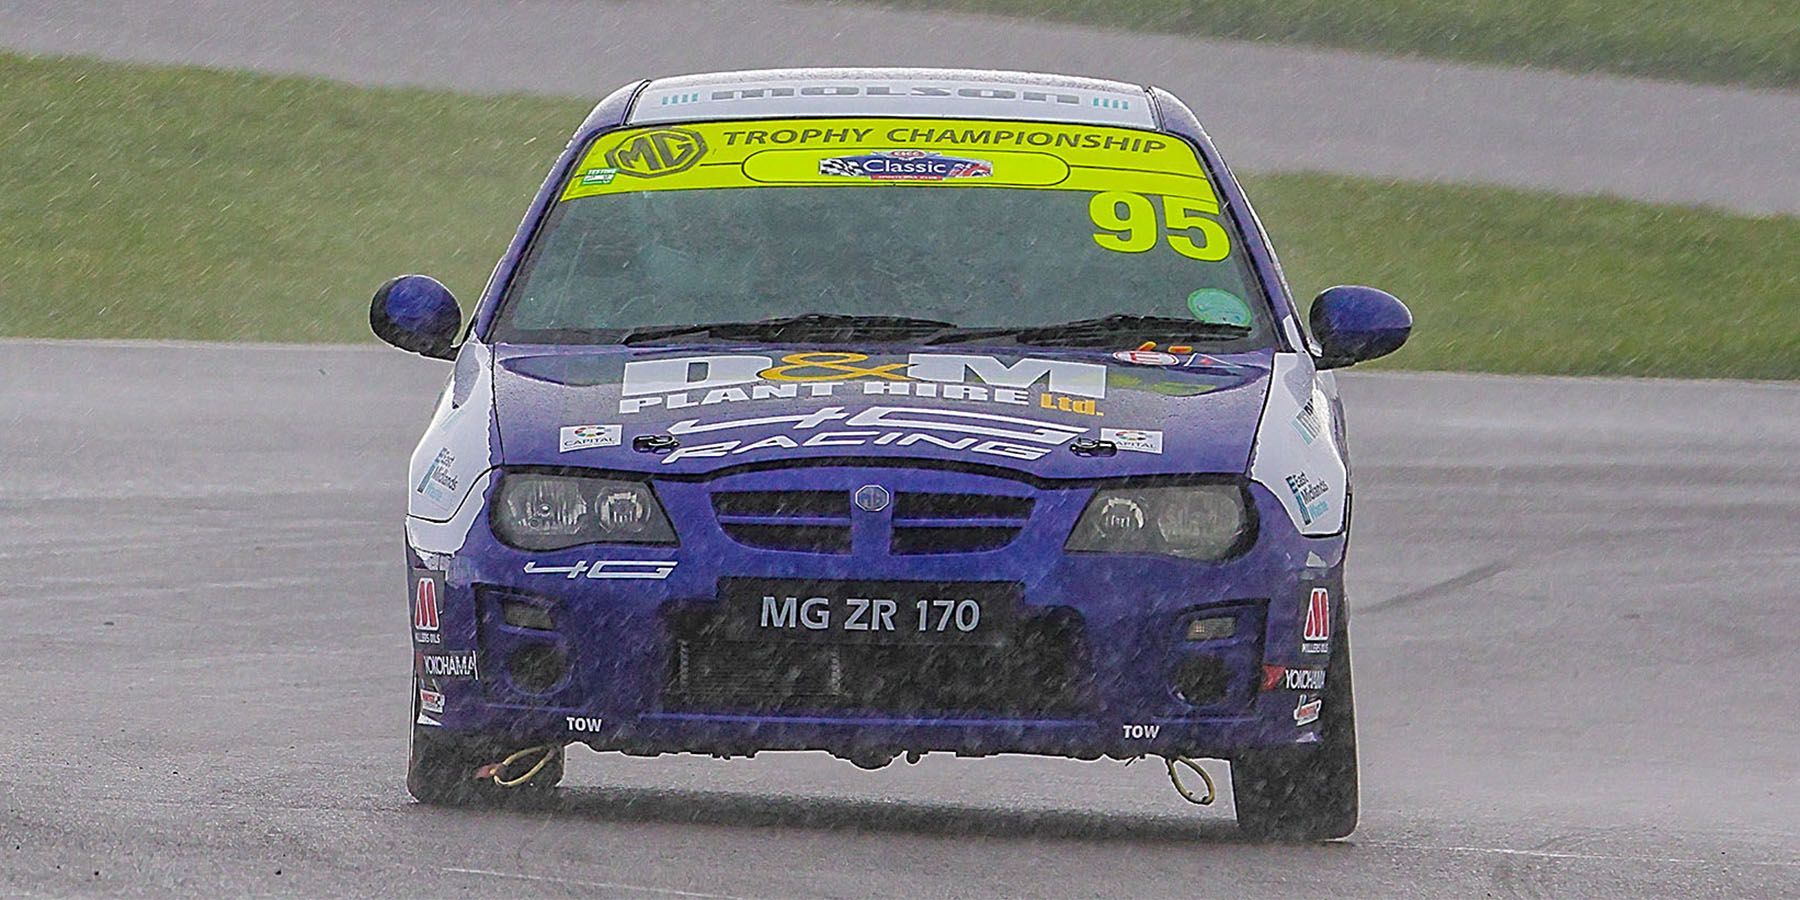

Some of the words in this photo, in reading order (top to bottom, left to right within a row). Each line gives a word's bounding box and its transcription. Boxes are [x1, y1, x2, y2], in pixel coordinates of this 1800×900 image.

[616, 132, 696, 171] MG
[723, 128, 873, 146] TROPHY
[887, 128, 1166, 153] CHAMPIONSHIP
[863, 159, 947, 173] Classic
[1089, 191, 1231, 262] 95
[619, 382, 844, 414] PLANT
[863, 382, 1029, 405] HIRE
[1040, 392, 1104, 416] Ltd.
[564, 437, 615, 447] CAPITAL
[661, 431, 1052, 465] RACING
[1115, 441, 1156, 449] APITAL
[523, 560, 678, 579] 4G
[760, 596, 829, 629] MG
[844, 599, 897, 631] ZR
[916, 600, 980, 632] 170
[566, 716, 601, 732] TOW
[1123, 725, 1159, 739] TOW
